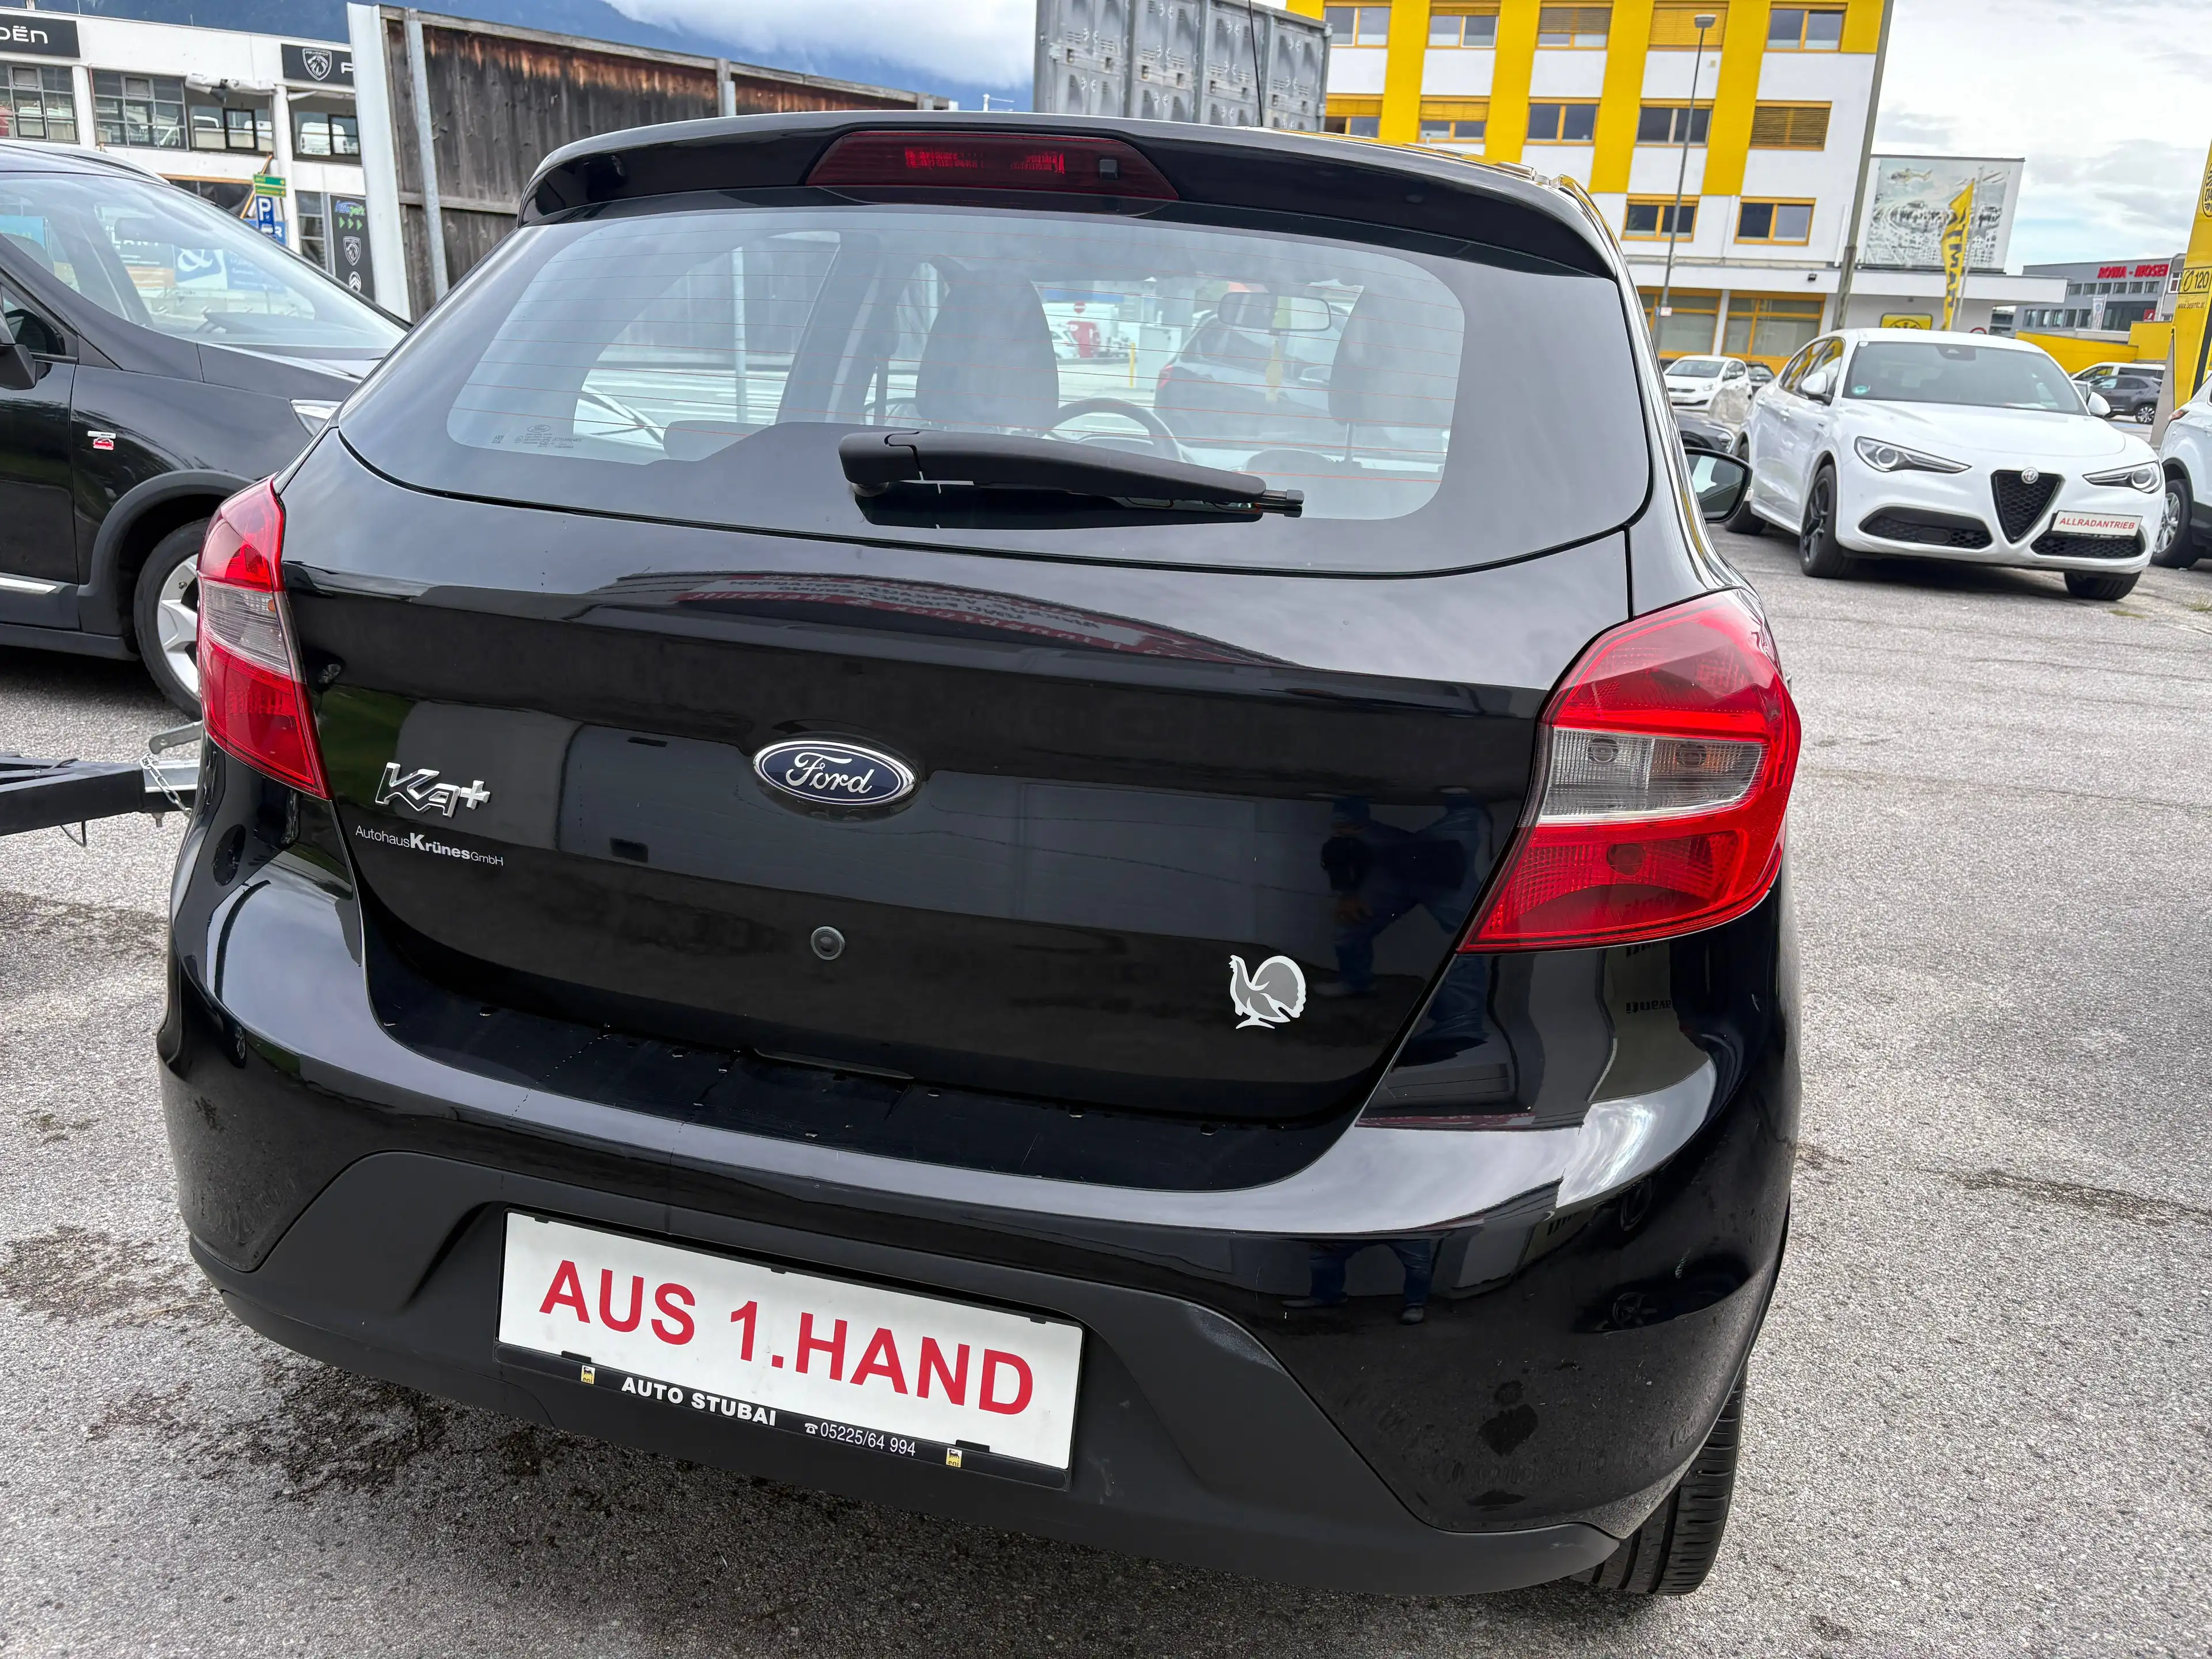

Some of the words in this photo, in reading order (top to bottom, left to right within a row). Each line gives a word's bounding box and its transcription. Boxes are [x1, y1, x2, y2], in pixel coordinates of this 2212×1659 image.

[259, 198, 271, 221] P
[2195, 271, 2210, 289] 120
[2059, 518, 2135, 529] ALLRADANTRIEB
[786, 752, 874, 794] Ford
[540, 1260, 695, 1344] AUS
[731, 1301, 1032, 1415] 1.HAND
[622, 1377, 684, 1404] AUTO
[691, 1392, 776, 1426] STUBAI
[820, 1422, 885, 1450] 05225/64
[890, 1437, 916, 1456] 994
